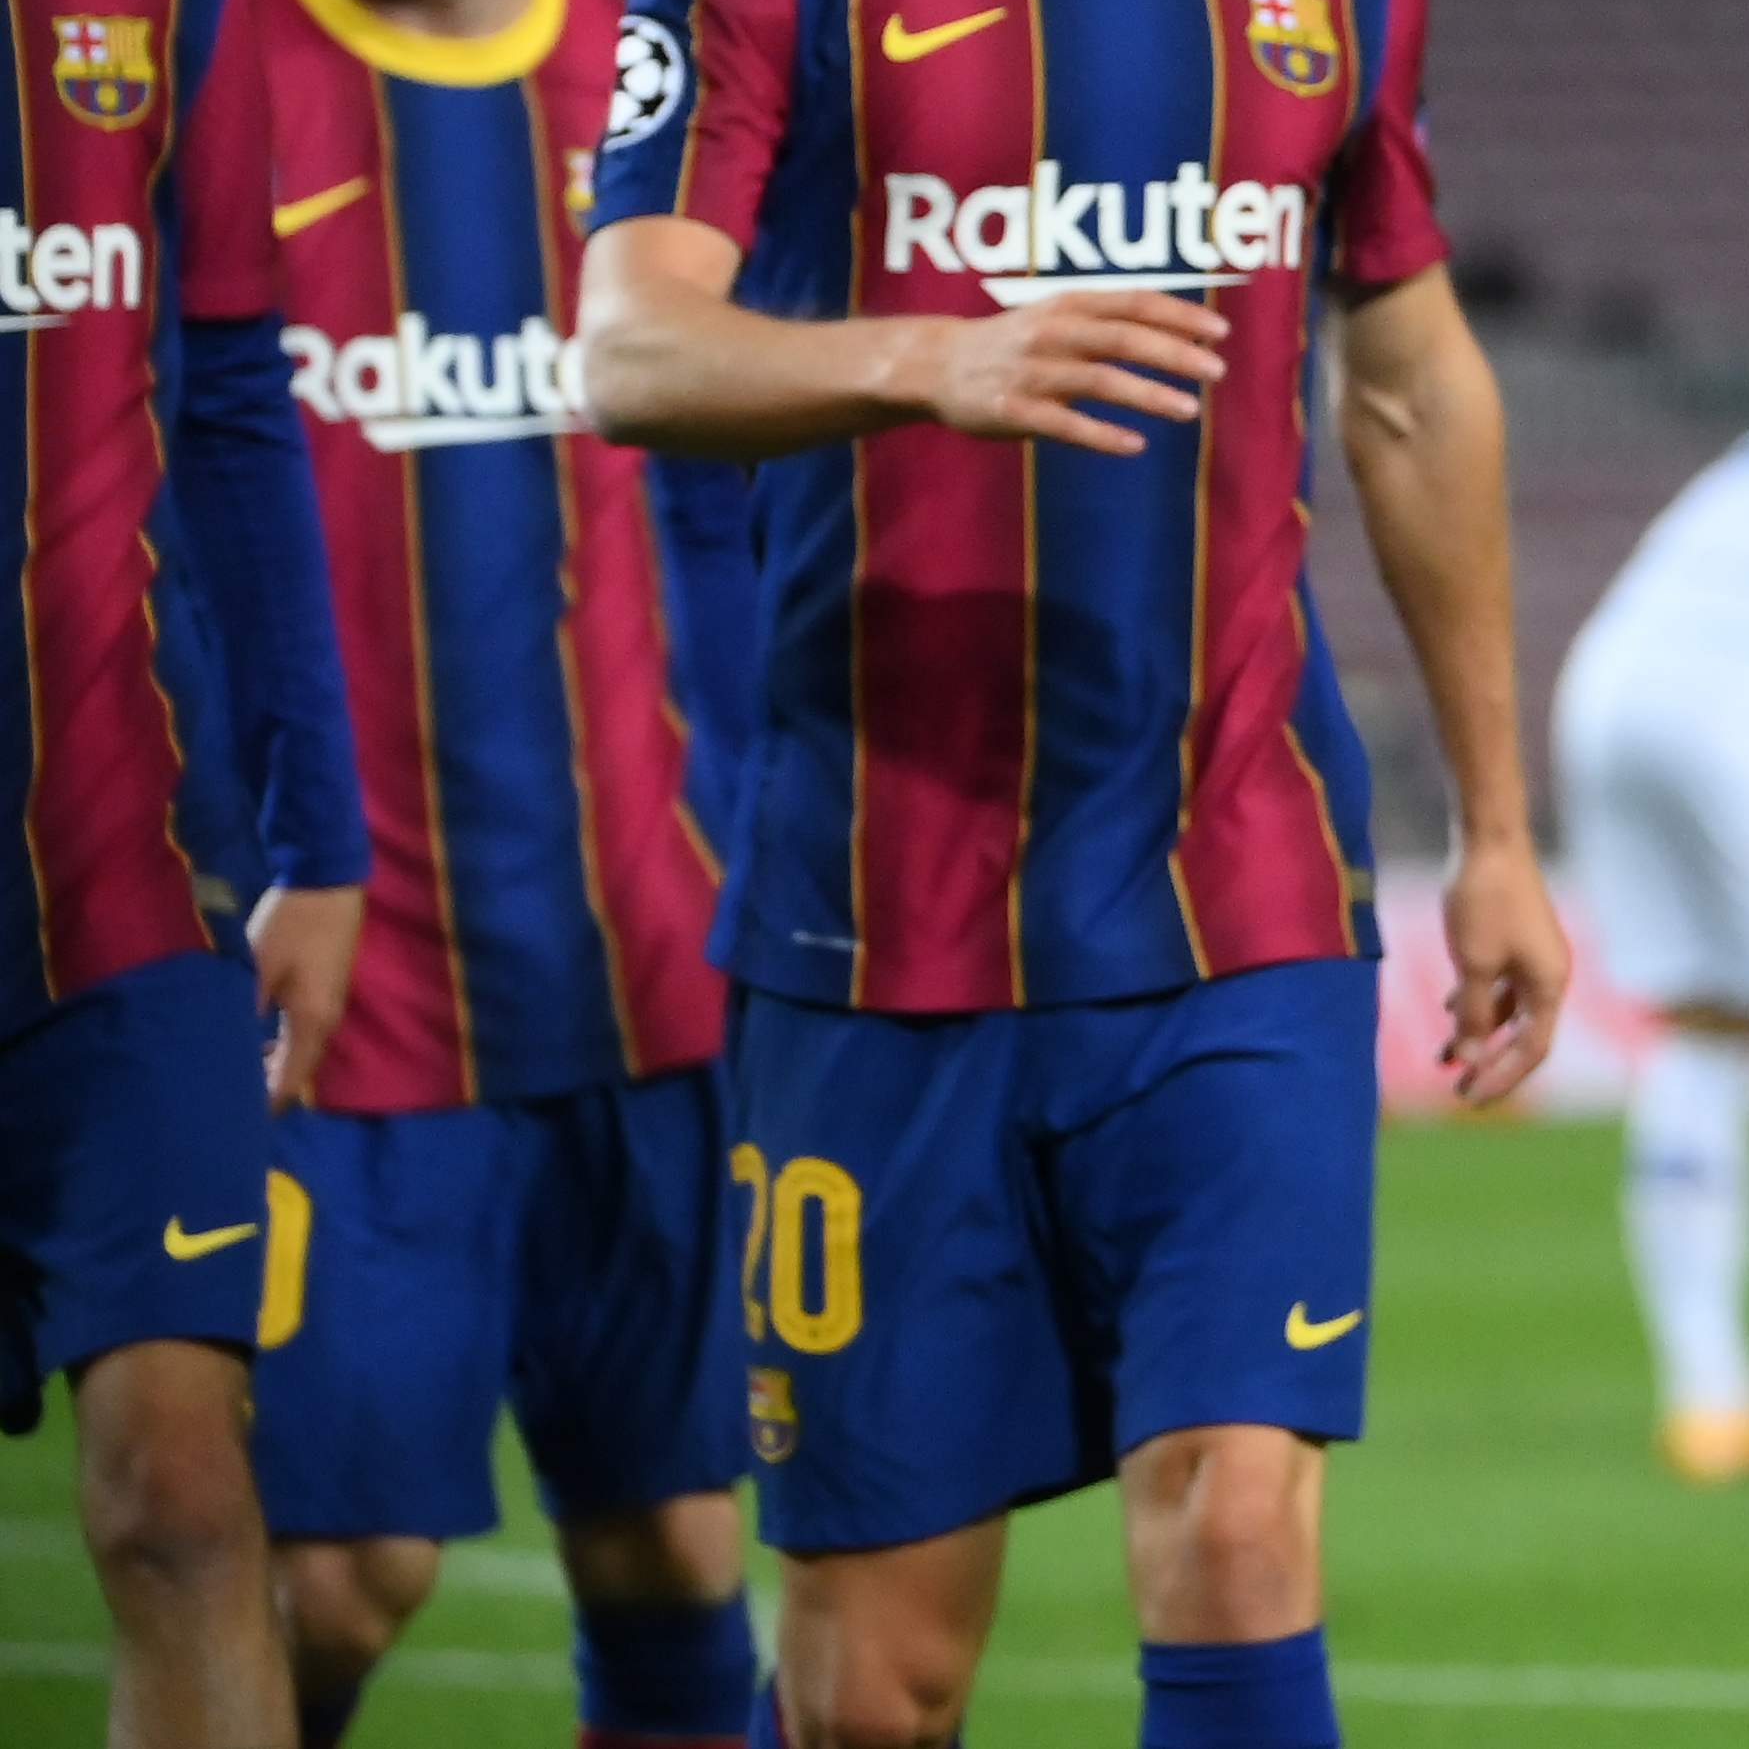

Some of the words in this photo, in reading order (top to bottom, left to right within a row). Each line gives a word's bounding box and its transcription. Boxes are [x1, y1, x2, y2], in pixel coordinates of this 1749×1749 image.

[0, 207, 144, 313] ten
[884, 159, 1306, 273] Rakuten
[729, 1142, 863, 1355] 20
